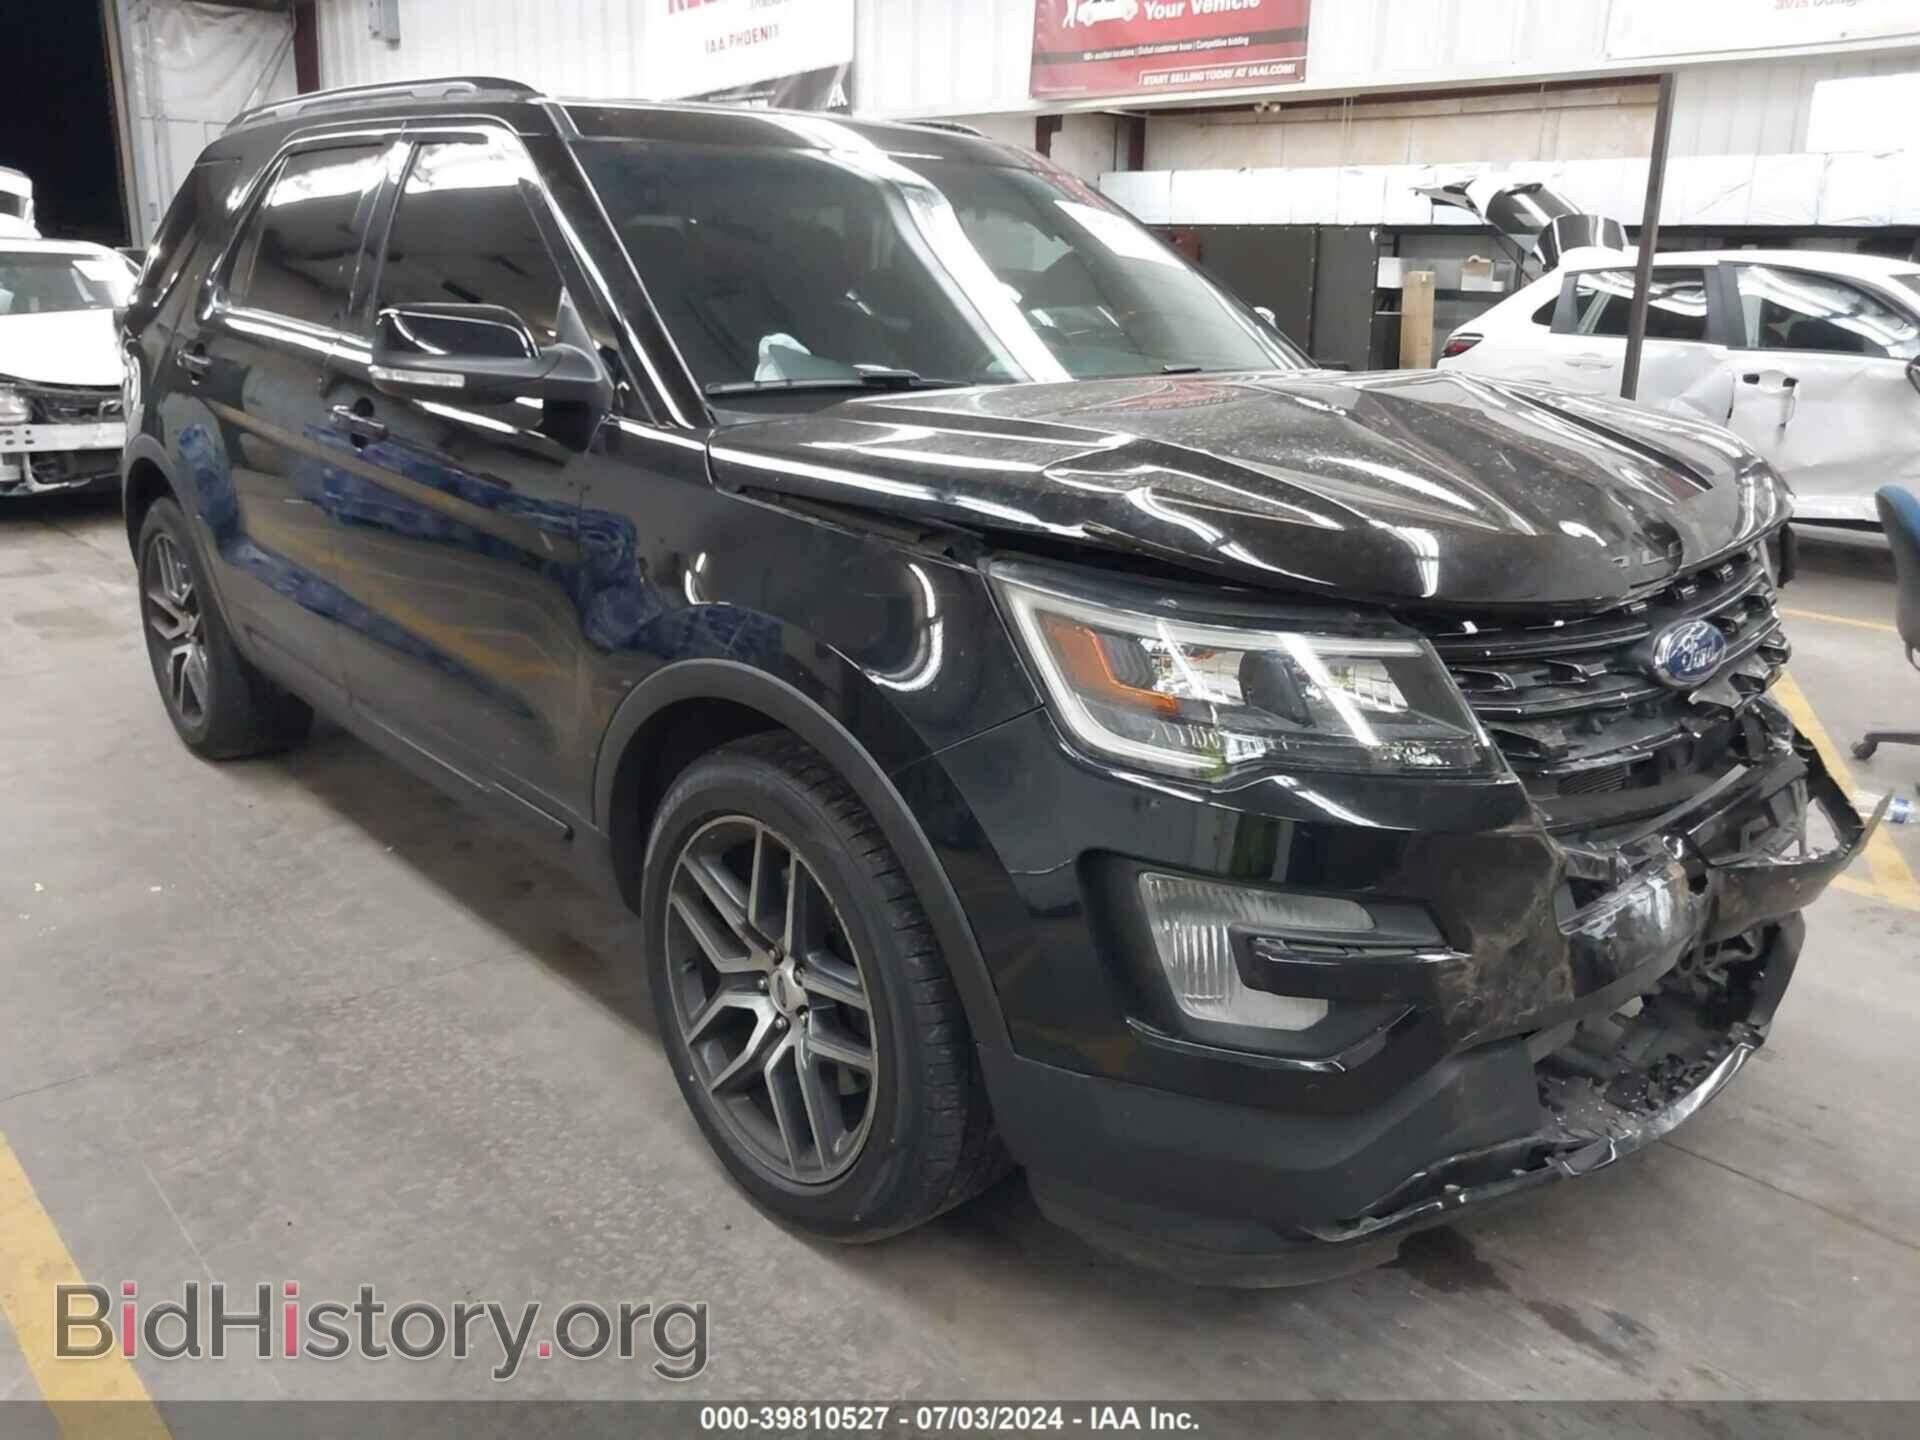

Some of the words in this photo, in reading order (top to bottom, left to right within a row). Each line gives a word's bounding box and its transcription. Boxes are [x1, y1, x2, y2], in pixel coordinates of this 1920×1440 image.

[1143, 0, 1184, 20] Your
[1191, 0, 1261, 15] Vehicle
[705, 37, 726, 54] IAA
[1143, 74, 1168, 86] START
[1171, 71, 1203, 83] SELLING
[1205, 69, 1234, 81] TODAY
[1235, 67, 1247, 78] AT
[1670, 620, 1719, 672] Ford
